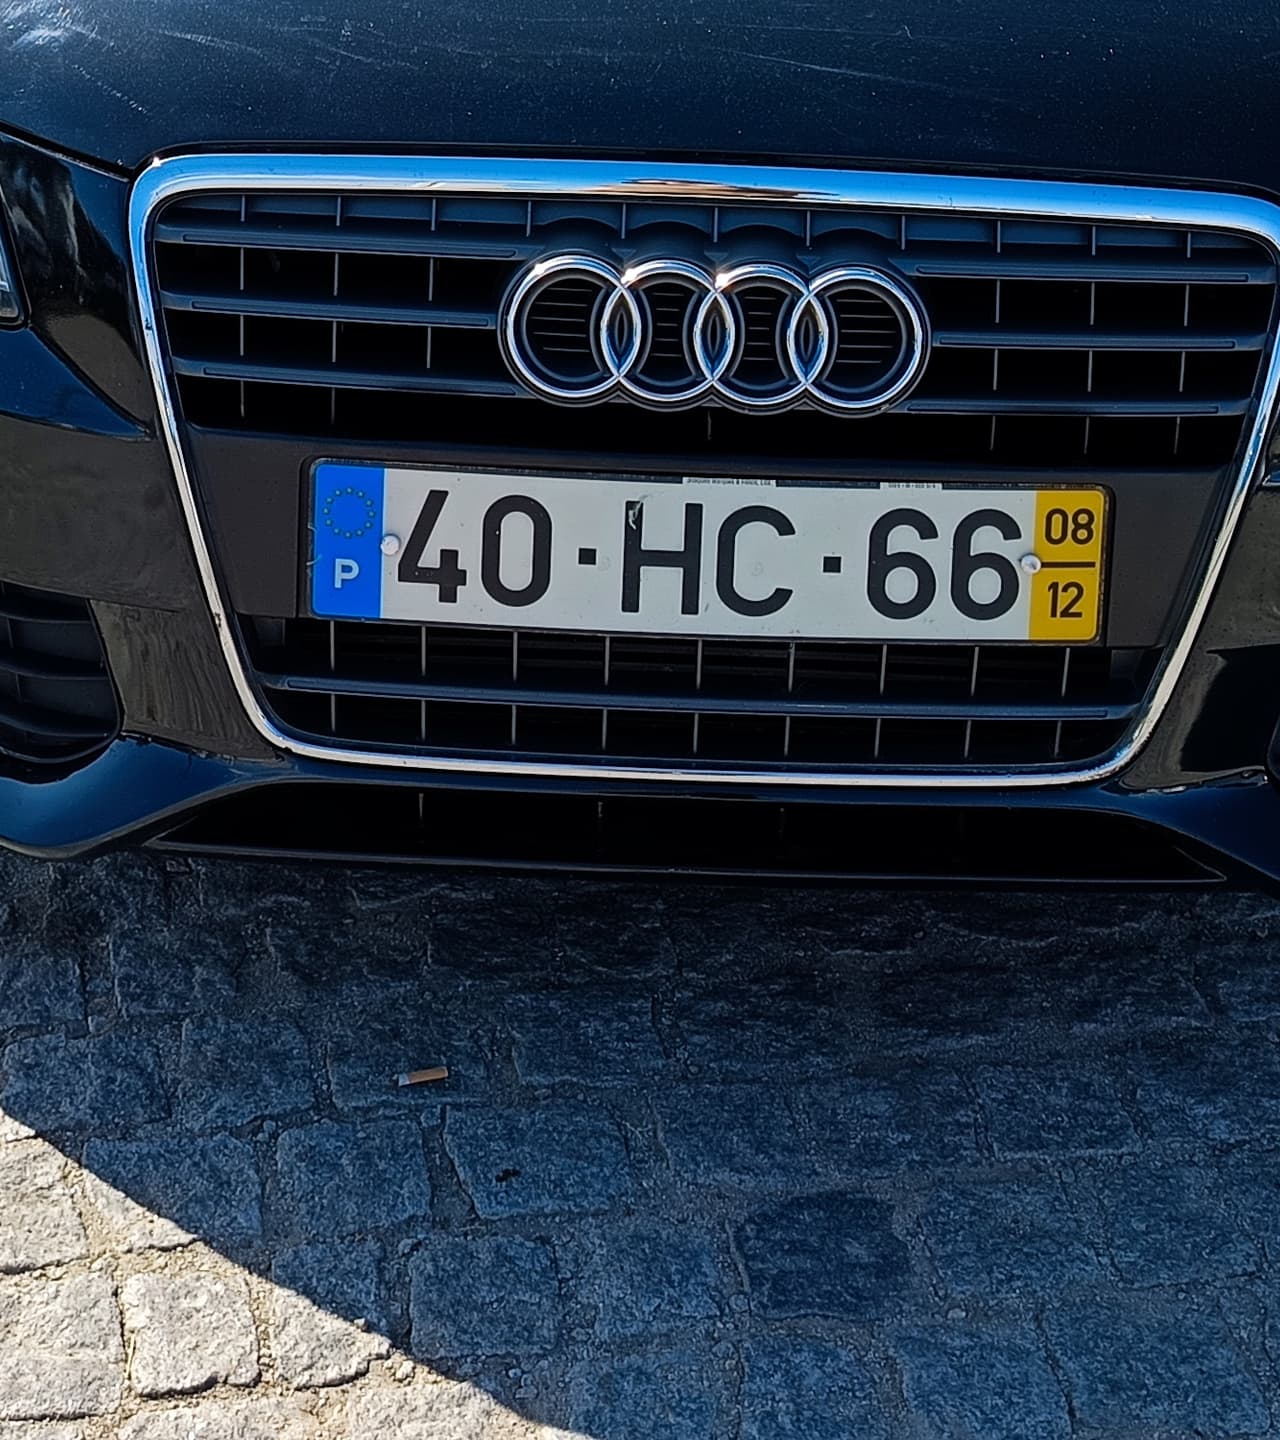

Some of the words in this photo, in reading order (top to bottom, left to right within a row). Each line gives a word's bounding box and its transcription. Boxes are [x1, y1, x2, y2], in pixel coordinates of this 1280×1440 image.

[1044, 507, 1095, 546] 08
[333, 558, 360, 589] P
[1047, 581, 1085, 619] 12
